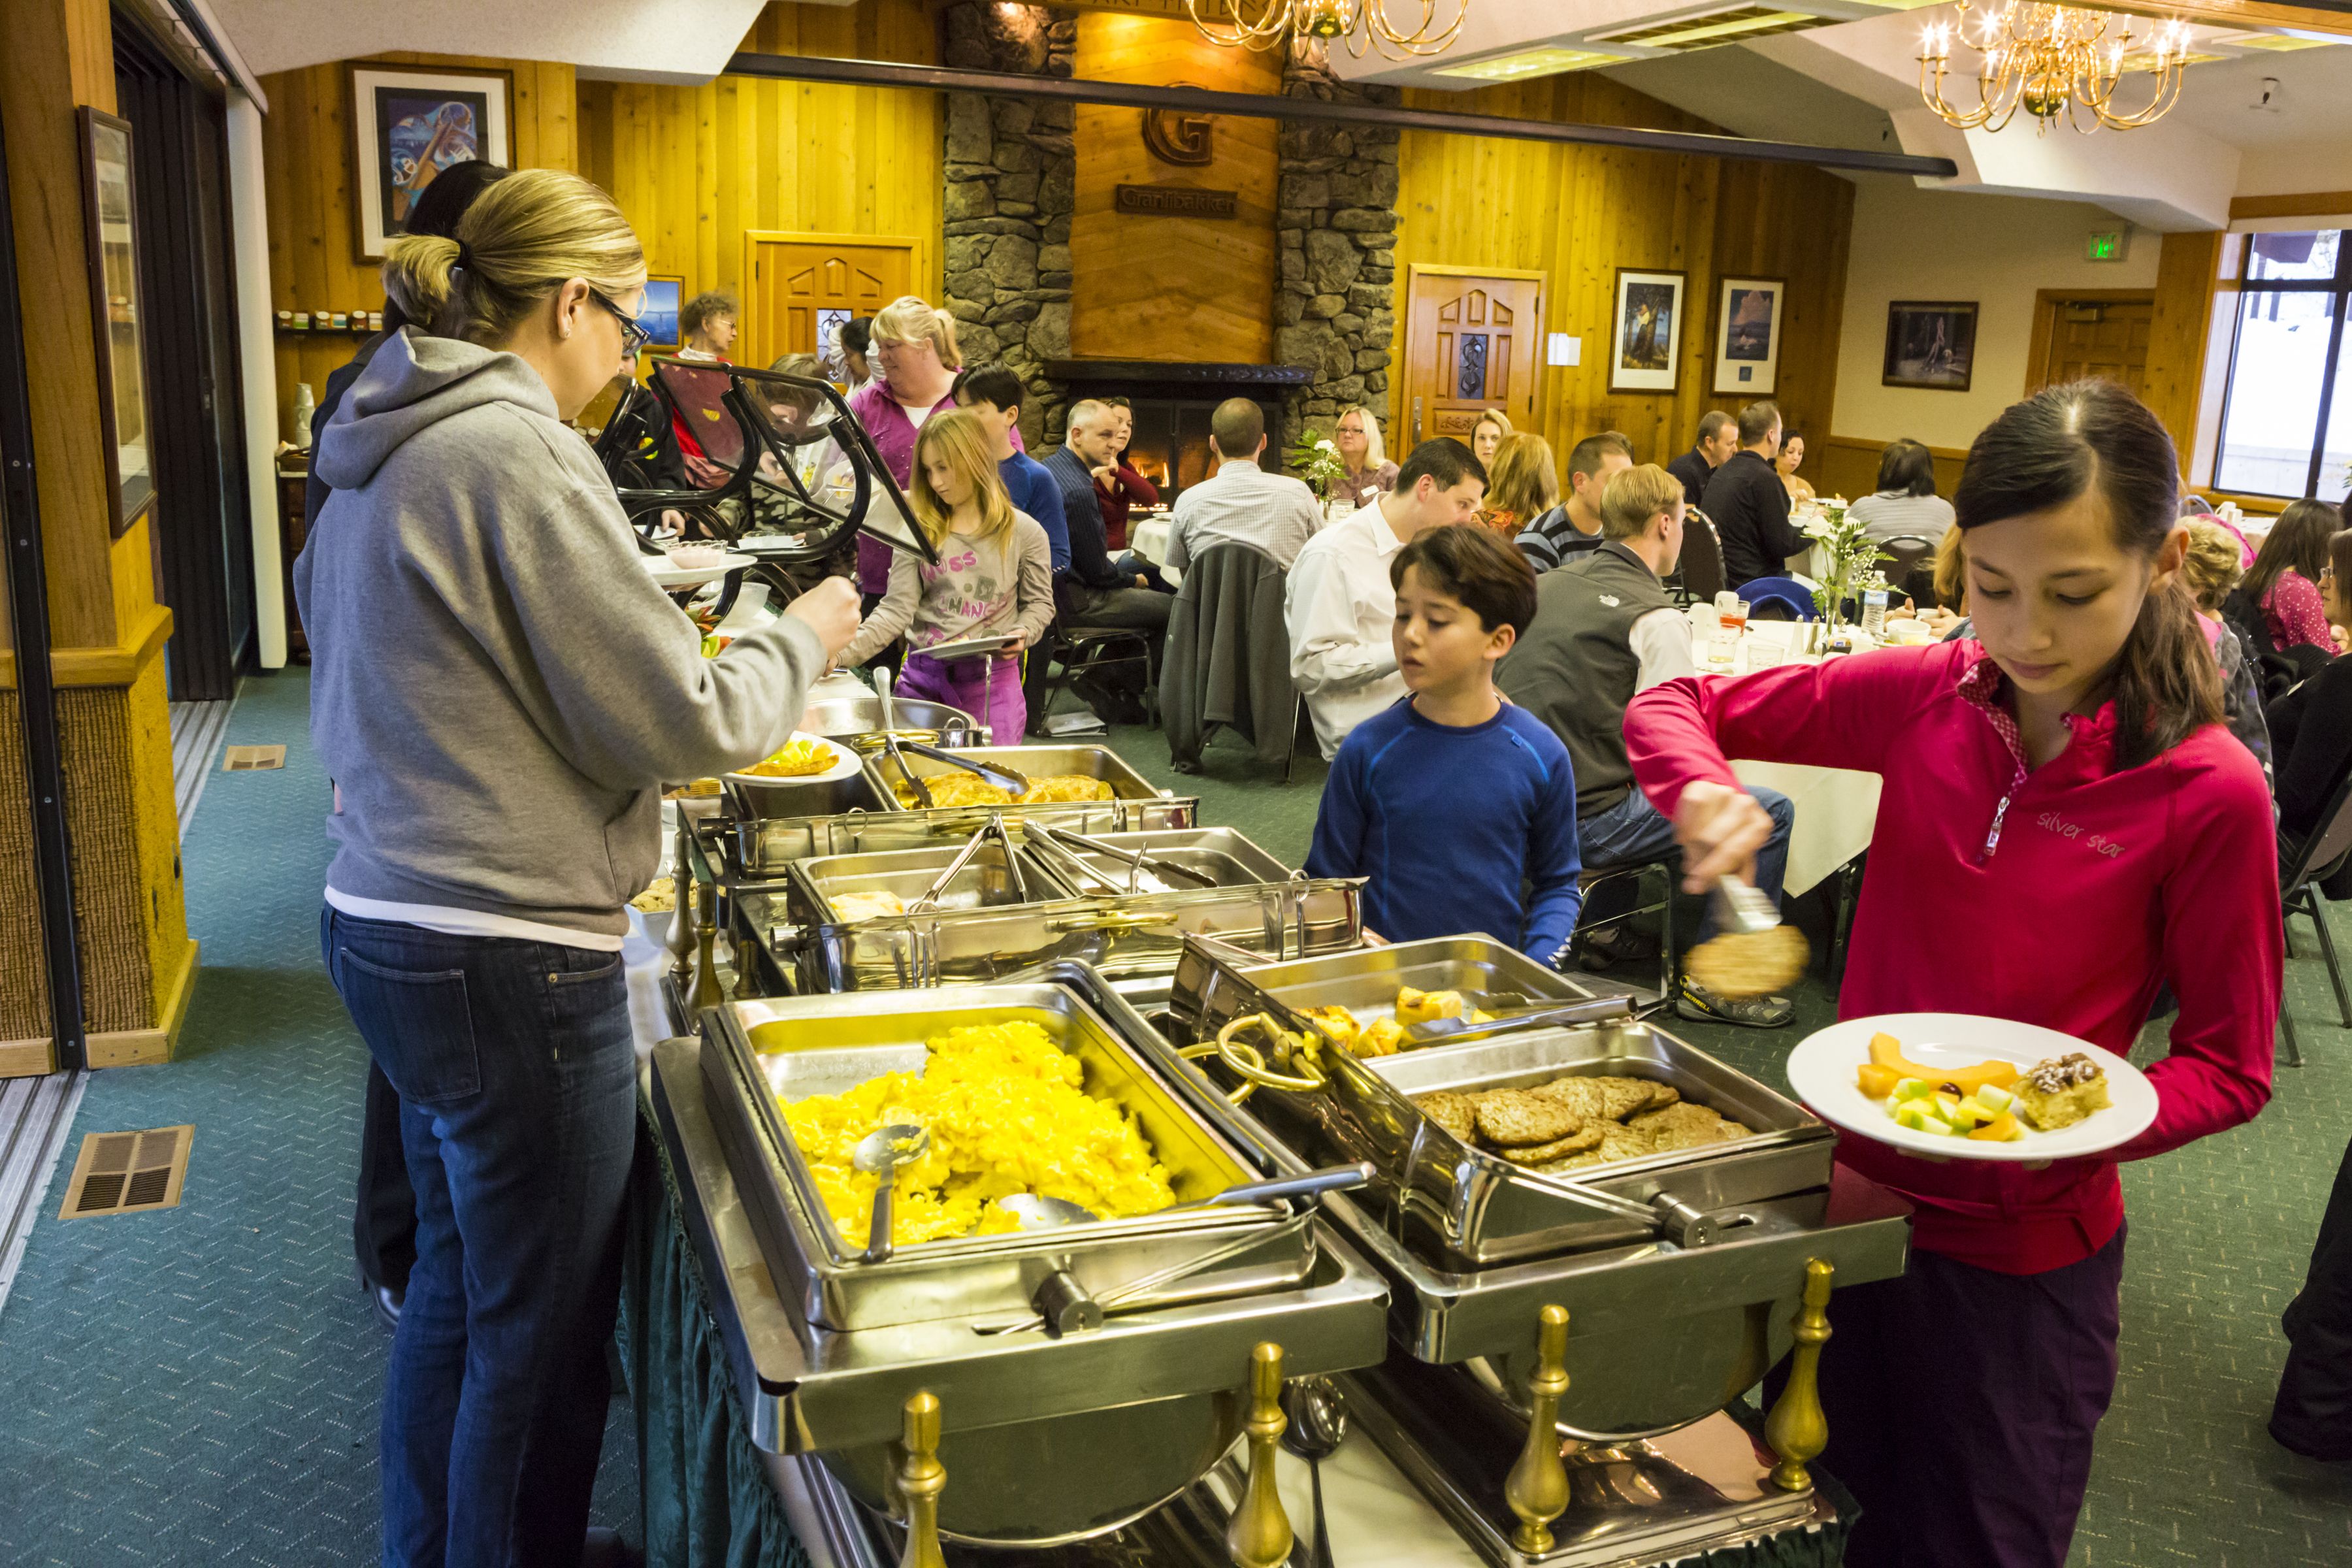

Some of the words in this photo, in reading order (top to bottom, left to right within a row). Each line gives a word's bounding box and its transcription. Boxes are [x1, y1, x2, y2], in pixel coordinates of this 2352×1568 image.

[1142, 80, 1214, 167] G
[1121, 188, 1235, 214] Granlibakken
[2036, 811, 2085, 840] silver
[2086, 834, 2126, 858] star
[1682, 990, 1710, 1013] MERRELL
